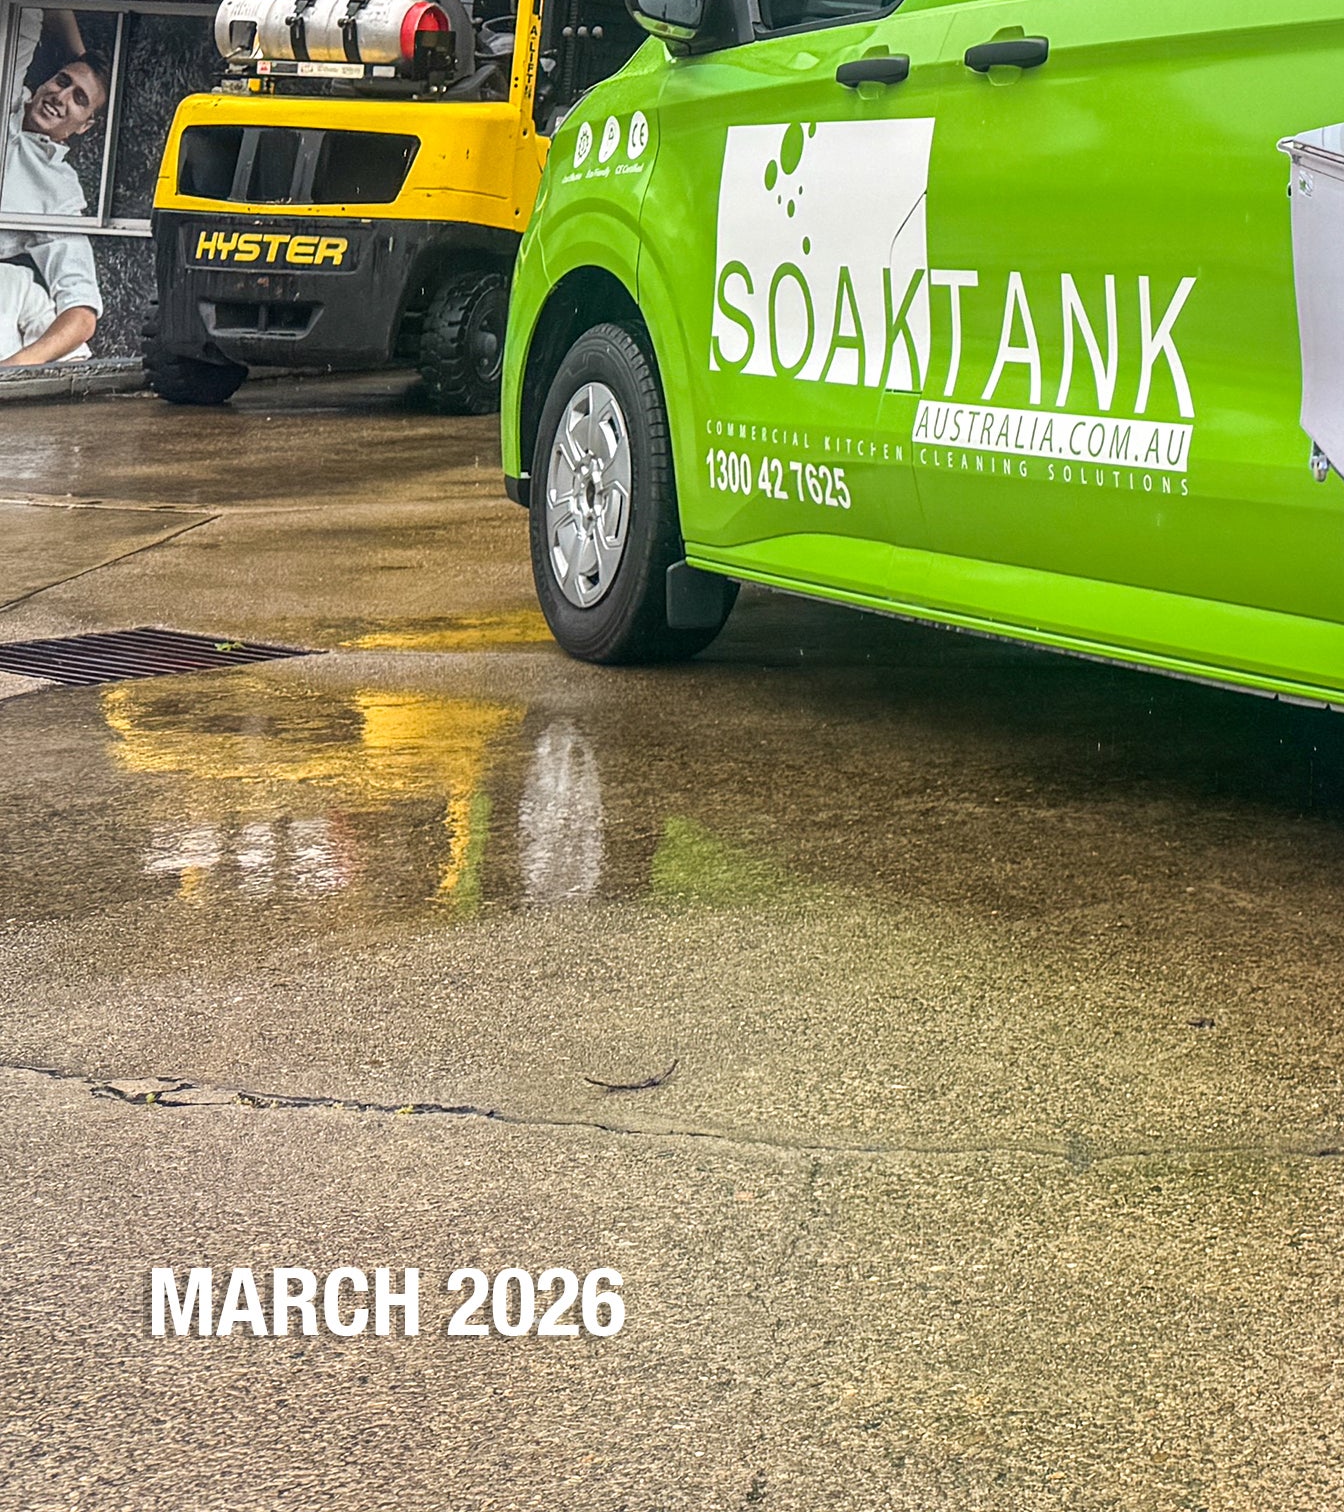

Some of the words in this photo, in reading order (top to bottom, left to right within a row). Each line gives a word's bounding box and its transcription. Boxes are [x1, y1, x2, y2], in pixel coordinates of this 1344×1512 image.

[195, 231, 348, 266] HYSTER
[711, 259, 1196, 417] SOAKTANK
[706, 419, 809, 448] COMMERCIAL
[824, 436, 903, 461] KITCHEN
[920, 448, 1027, 477] CLEANING
[1047, 463, 1189, 496] SOLUTIONS
[915, 405, 1185, 466] AUSTRALIA.COM.AU
[706, 447, 751, 496] 1300
[757, 456, 789, 500] 42
[789, 460, 851, 510] 7625
